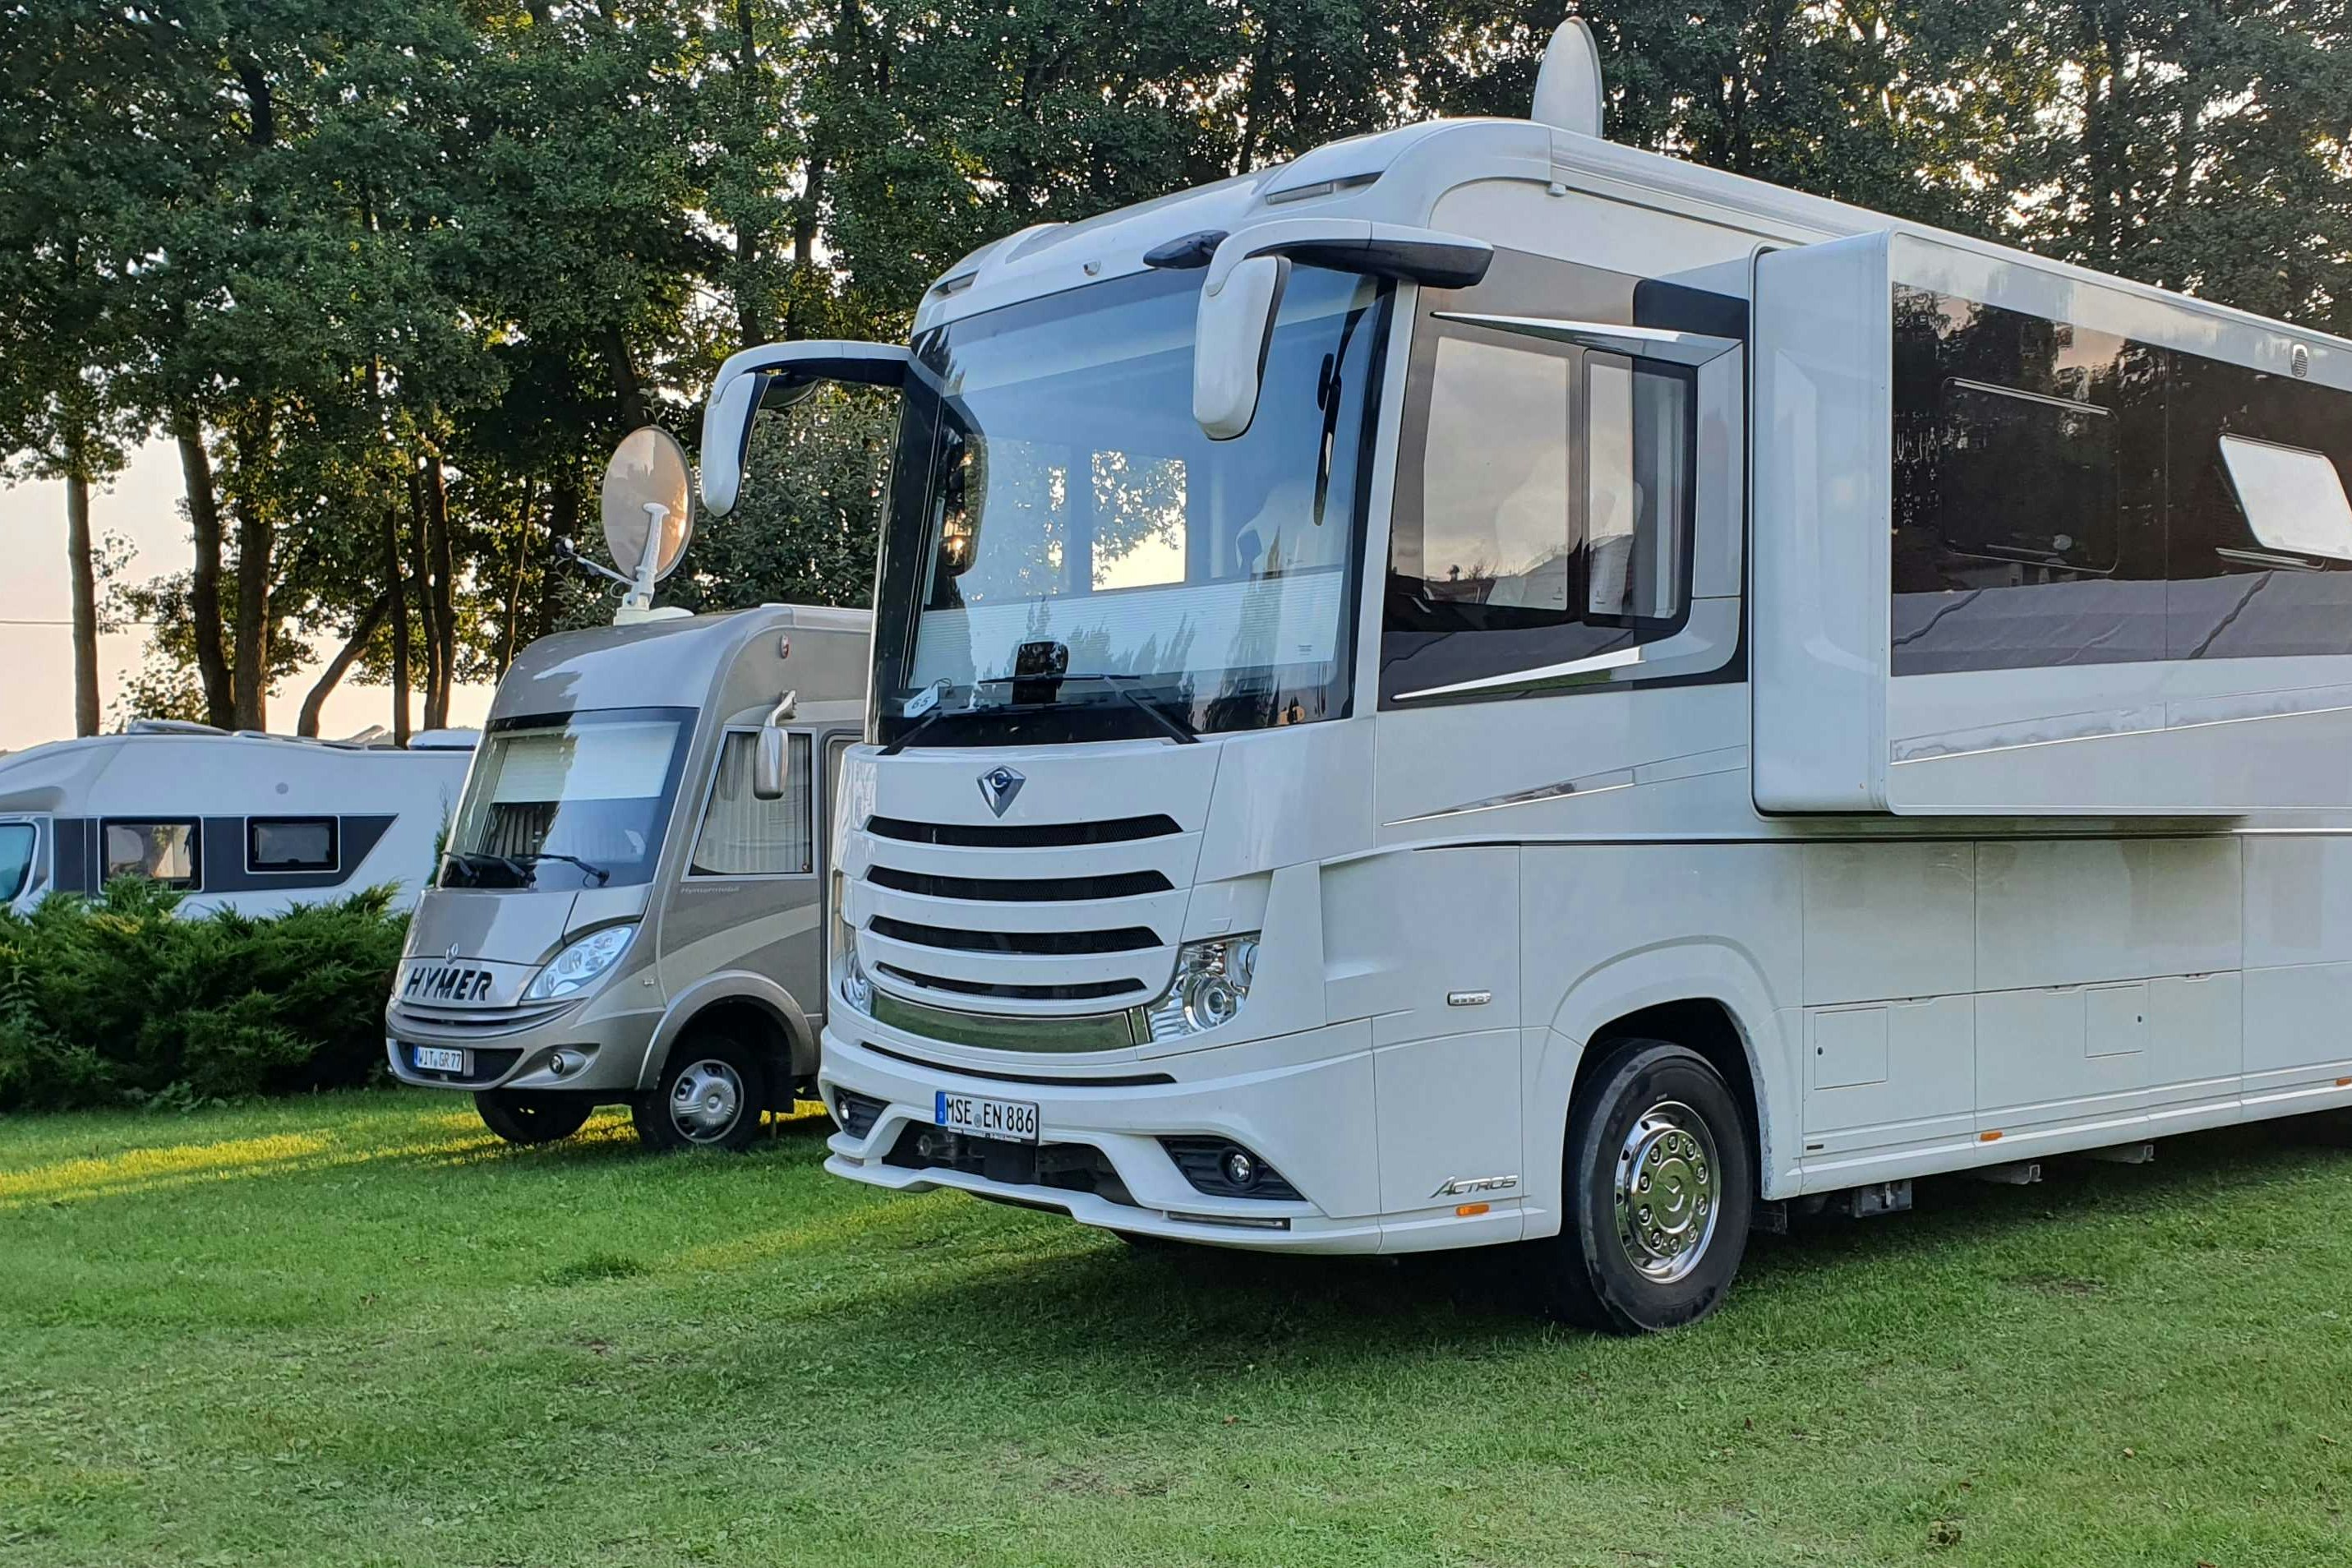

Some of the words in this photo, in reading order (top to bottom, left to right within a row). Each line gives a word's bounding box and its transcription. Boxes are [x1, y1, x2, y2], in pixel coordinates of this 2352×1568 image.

[911, 696, 930, 709] 65
[404, 966, 493, 1001] HYMER
[439, 1052, 450, 1068] GR
[451, 1053, 461, 1068] 77
[946, 1097, 972, 1125] MSE
[984, 1104, 1002, 1129] EN
[1007, 1106, 1034, 1133] 886
